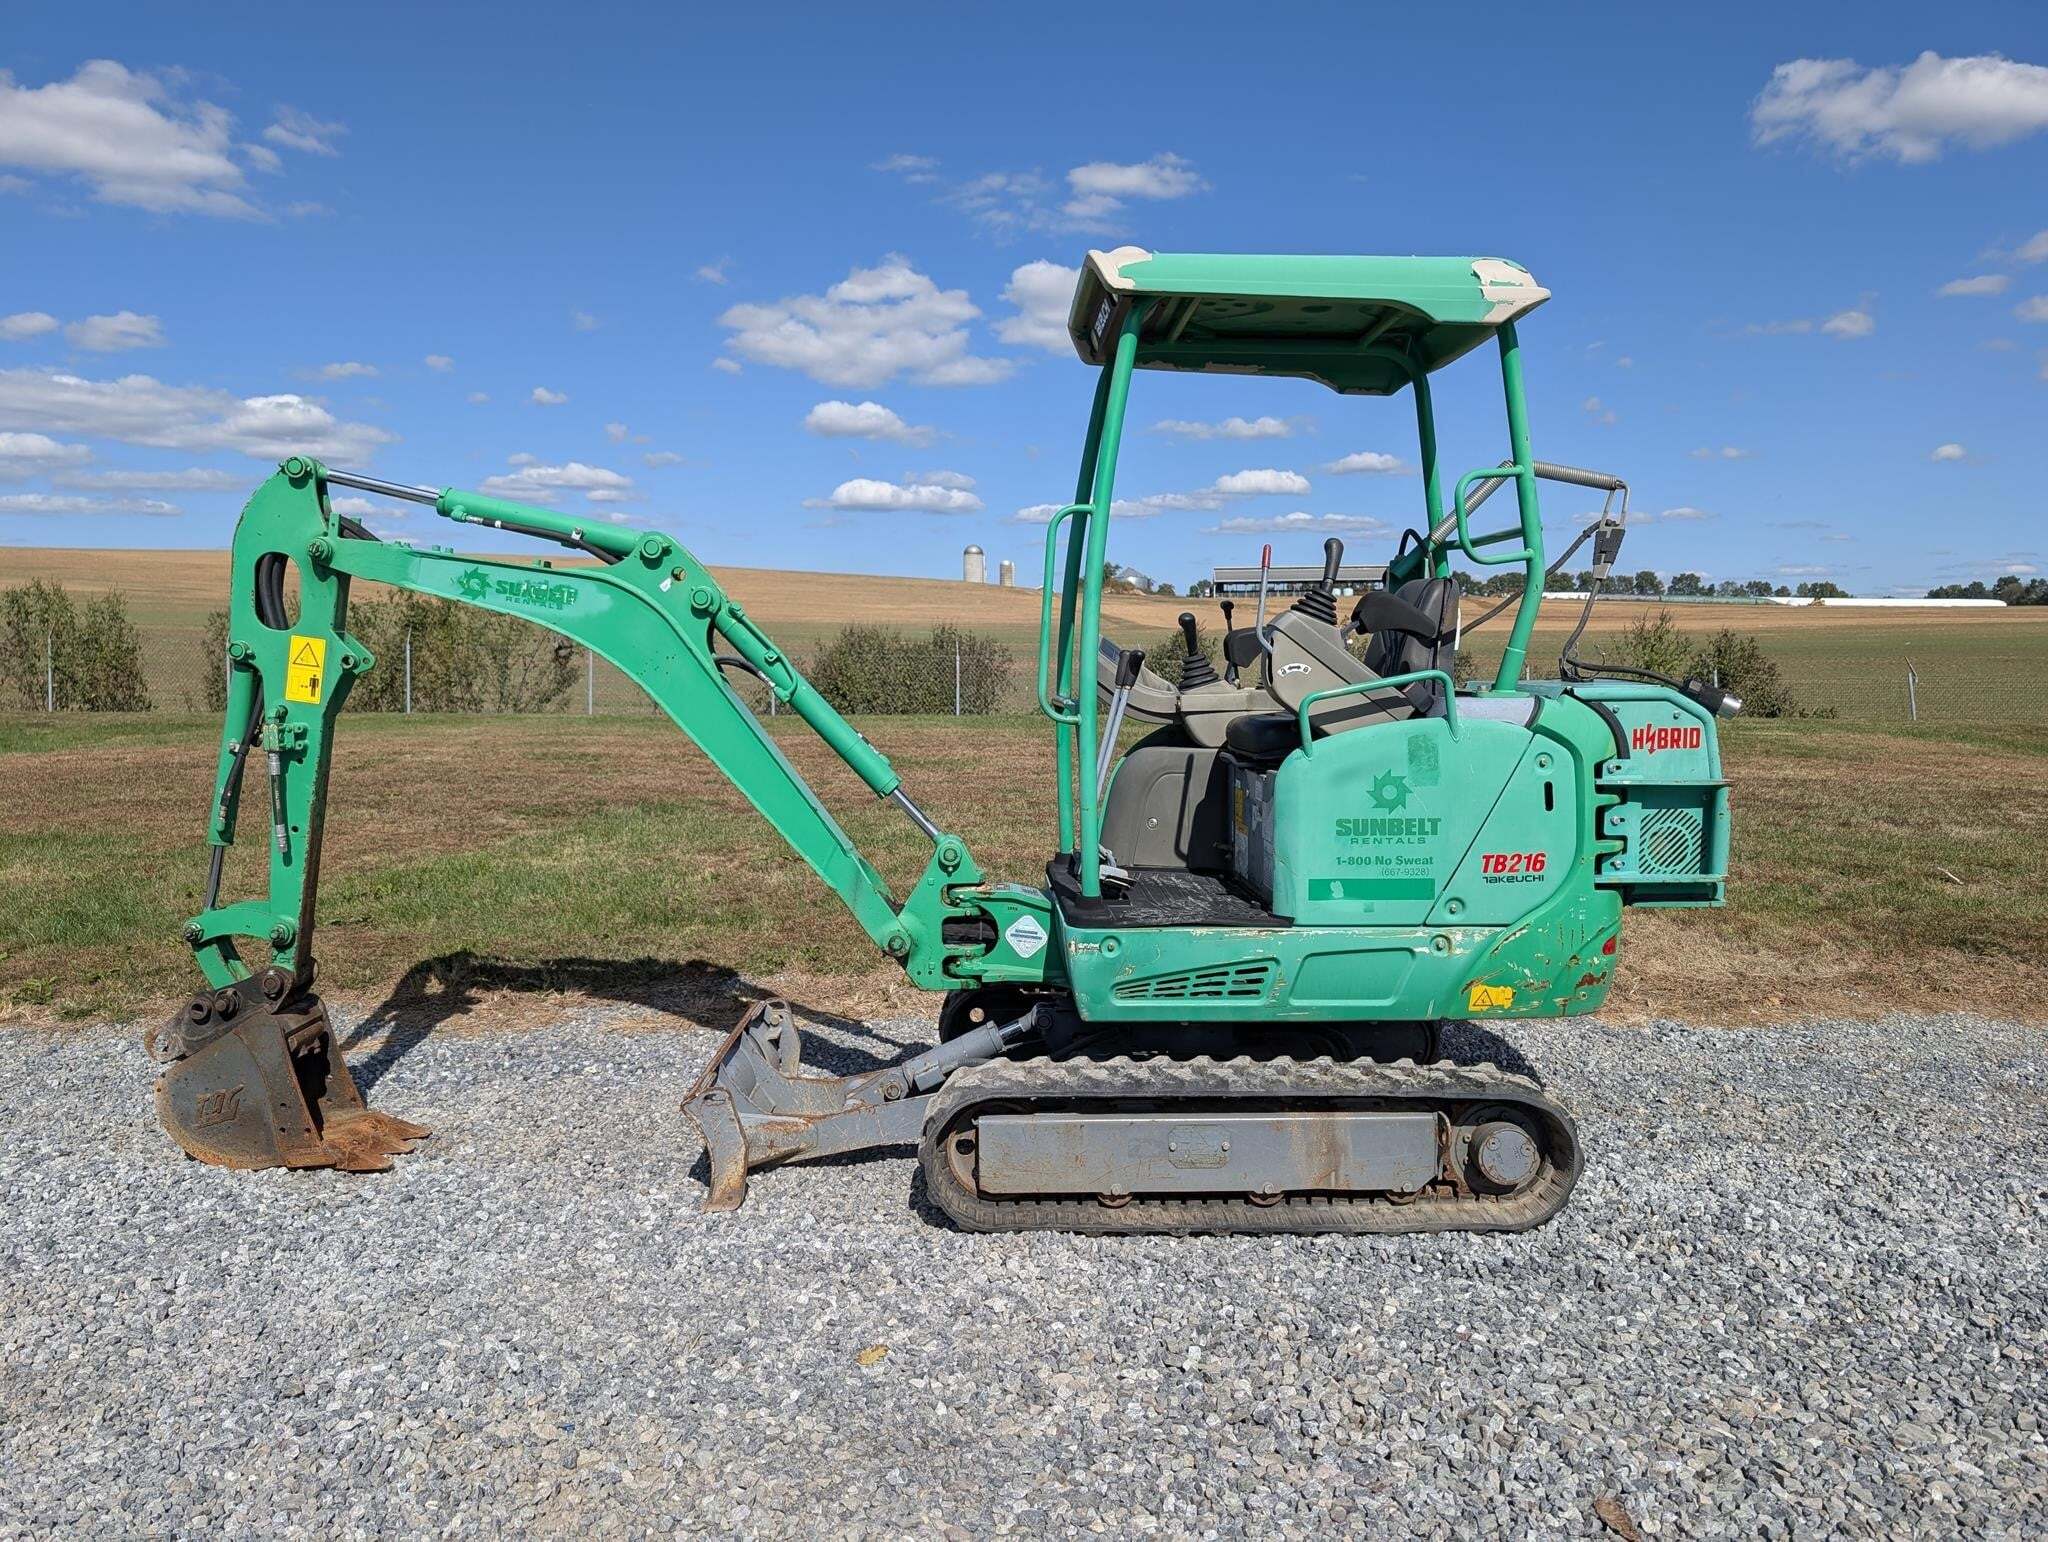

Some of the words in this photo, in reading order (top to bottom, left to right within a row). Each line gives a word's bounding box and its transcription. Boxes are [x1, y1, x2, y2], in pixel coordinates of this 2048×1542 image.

[1632, 724, 1701, 755] HYBRID
[1335, 818, 1442, 836] SUNBELT
[1350, 837, 1426, 845] RENTALS
[1336, 855, 1372, 866] 1-800
[1375, 855, 1393, 866] No
[1395, 855, 1434, 866] Sweat
[1482, 853, 1547, 874] TB216
[1381, 867, 1430, 877] (667-9328)
